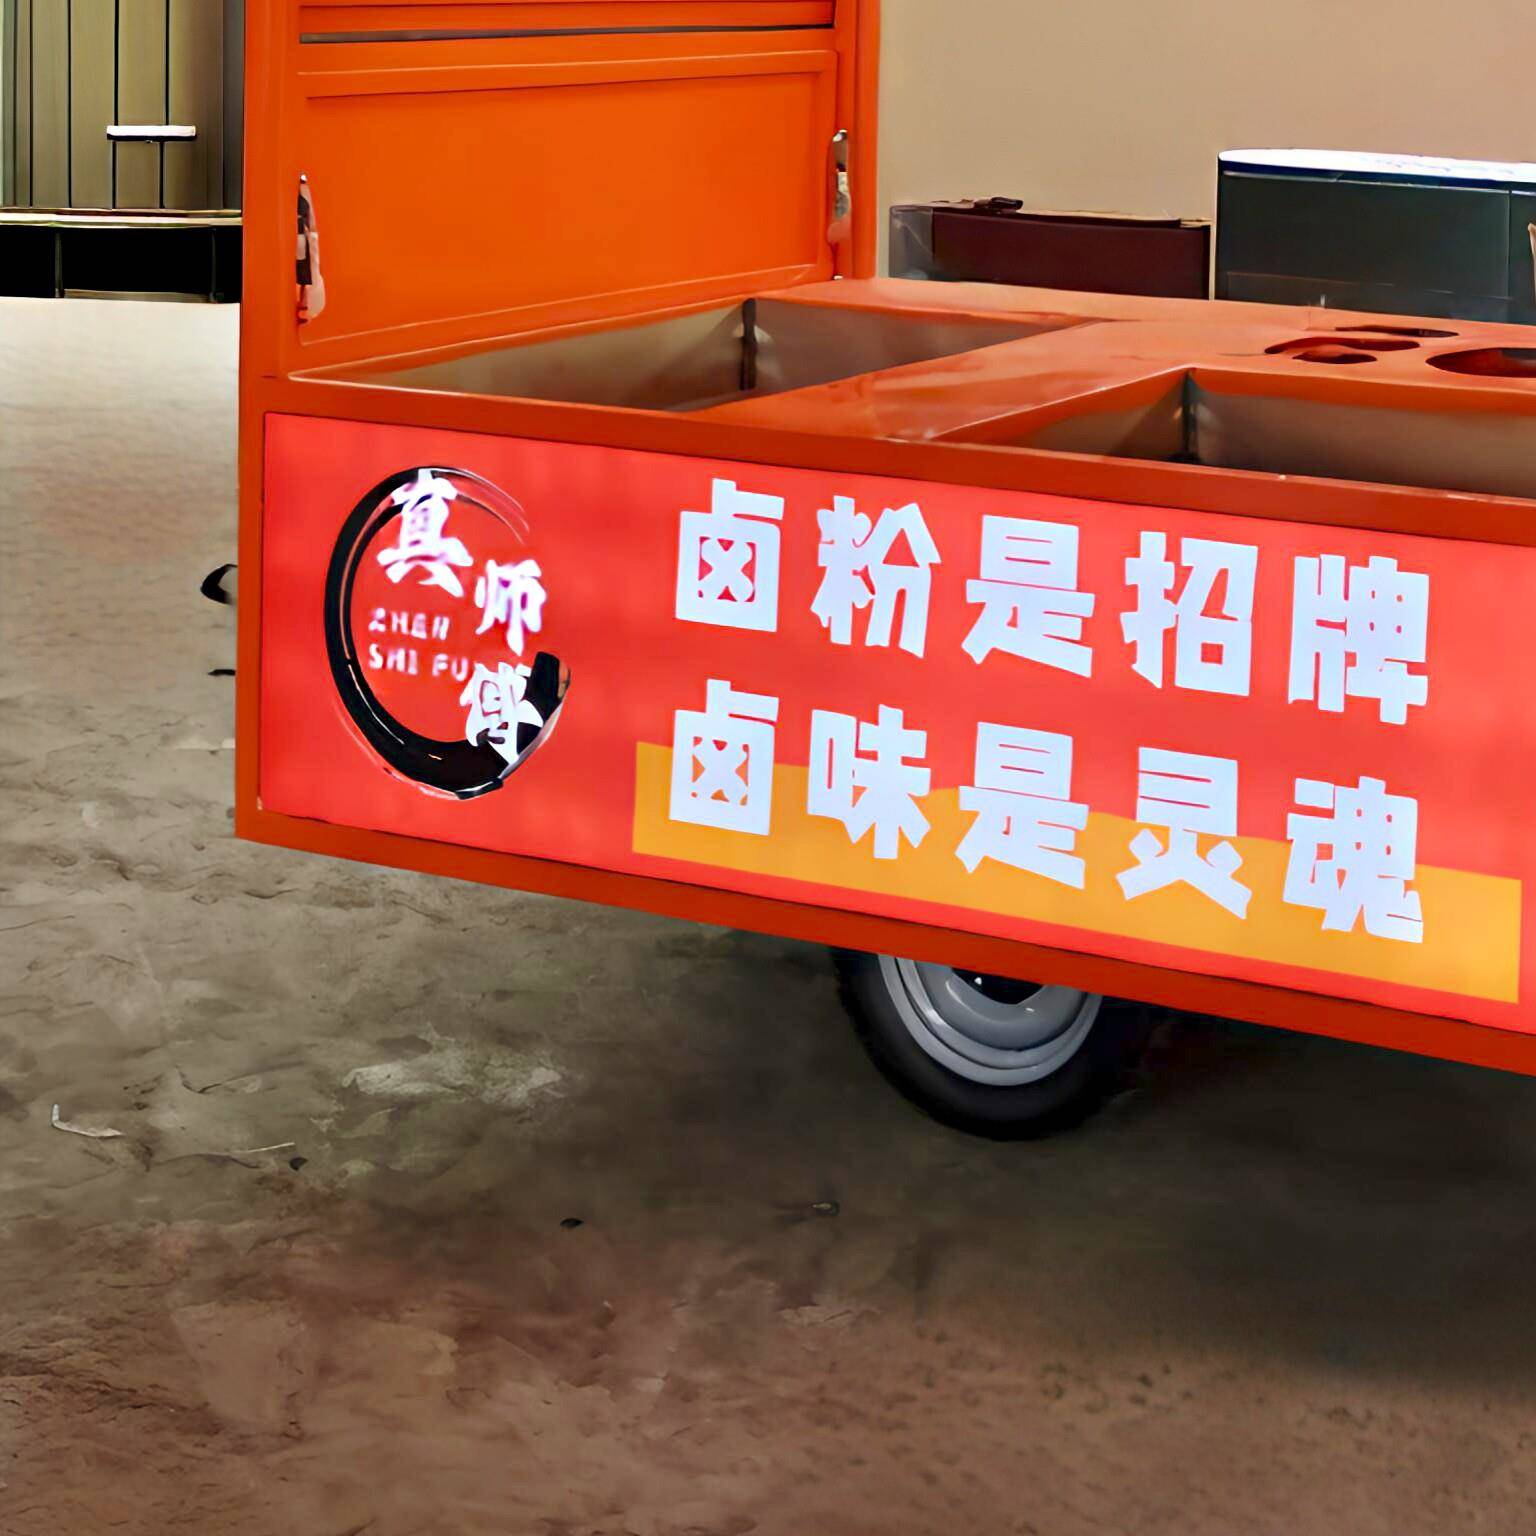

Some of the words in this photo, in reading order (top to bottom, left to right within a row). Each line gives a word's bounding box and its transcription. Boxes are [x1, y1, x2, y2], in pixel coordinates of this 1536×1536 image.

[432, 653, 468, 682] FU
[675, 478, 1430, 725] 卤粉是招牌
[668, 679, 1425, 944] 卤味是灵魂
